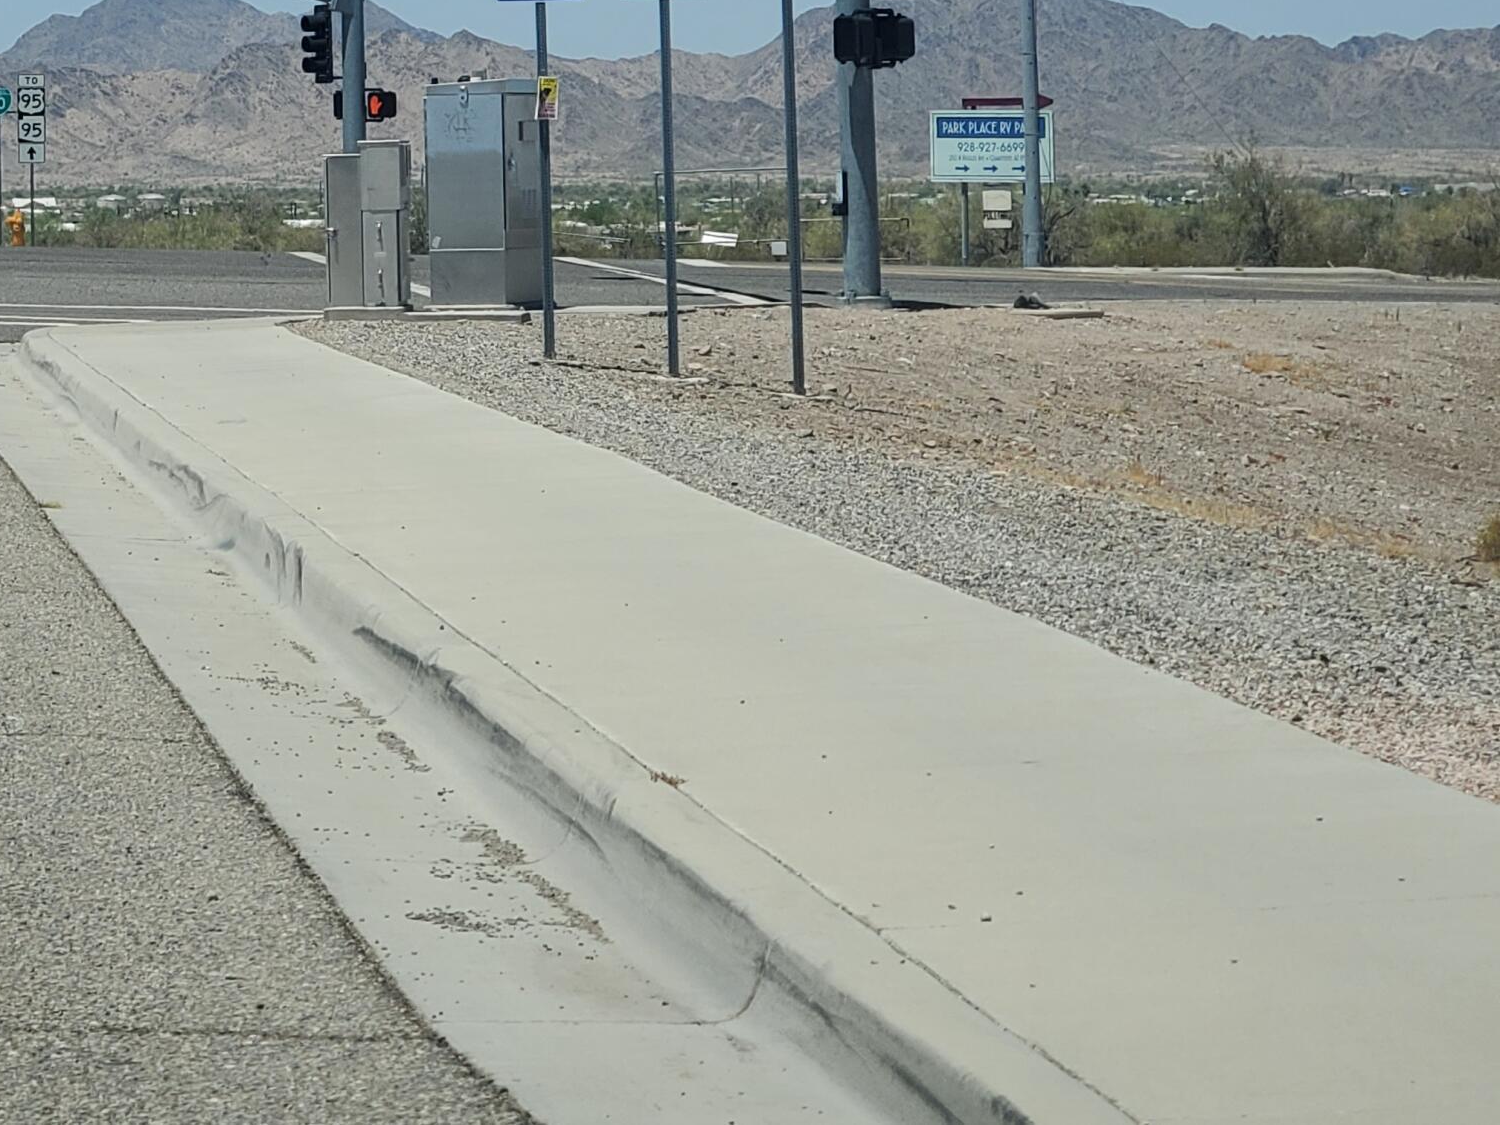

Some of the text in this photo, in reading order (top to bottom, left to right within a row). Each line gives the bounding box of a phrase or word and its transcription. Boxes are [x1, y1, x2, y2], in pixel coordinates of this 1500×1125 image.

[21, 94, 42, 109] 95
[21, 122, 42, 137] 95
[942, 121, 1025, 134] PARK PLACE RV PA
[957, 142, 1025, 153] 928-927-6699
